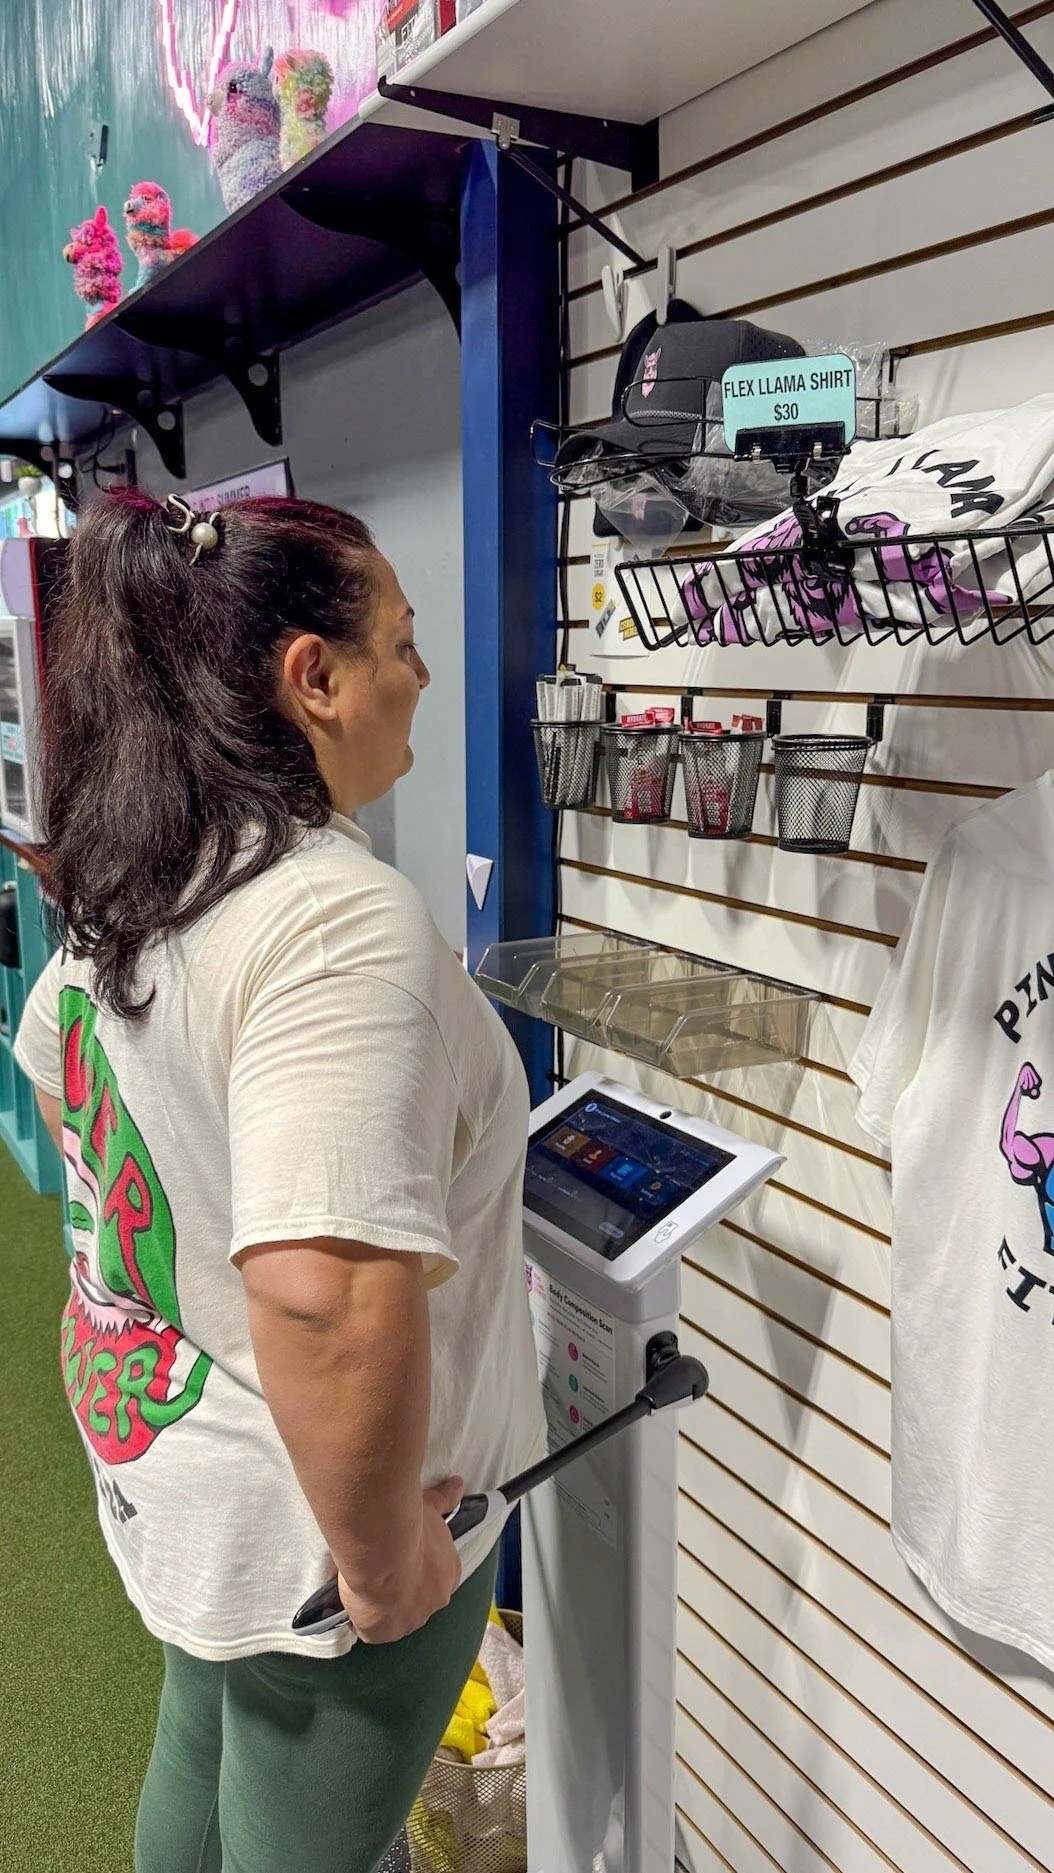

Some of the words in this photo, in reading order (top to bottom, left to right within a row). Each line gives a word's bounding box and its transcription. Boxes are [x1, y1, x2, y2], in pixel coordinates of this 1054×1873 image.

[724, 379, 754, 398] FLEX
[759, 374, 806, 395] LLAMA
[811, 369, 852, 390] SHIRT
[774, 403, 799, 423] $30
[549, 1283, 563, 1302] Body
[564, 1295, 598, 1325] Composition
[599, 1318, 613, 1335] Scan
